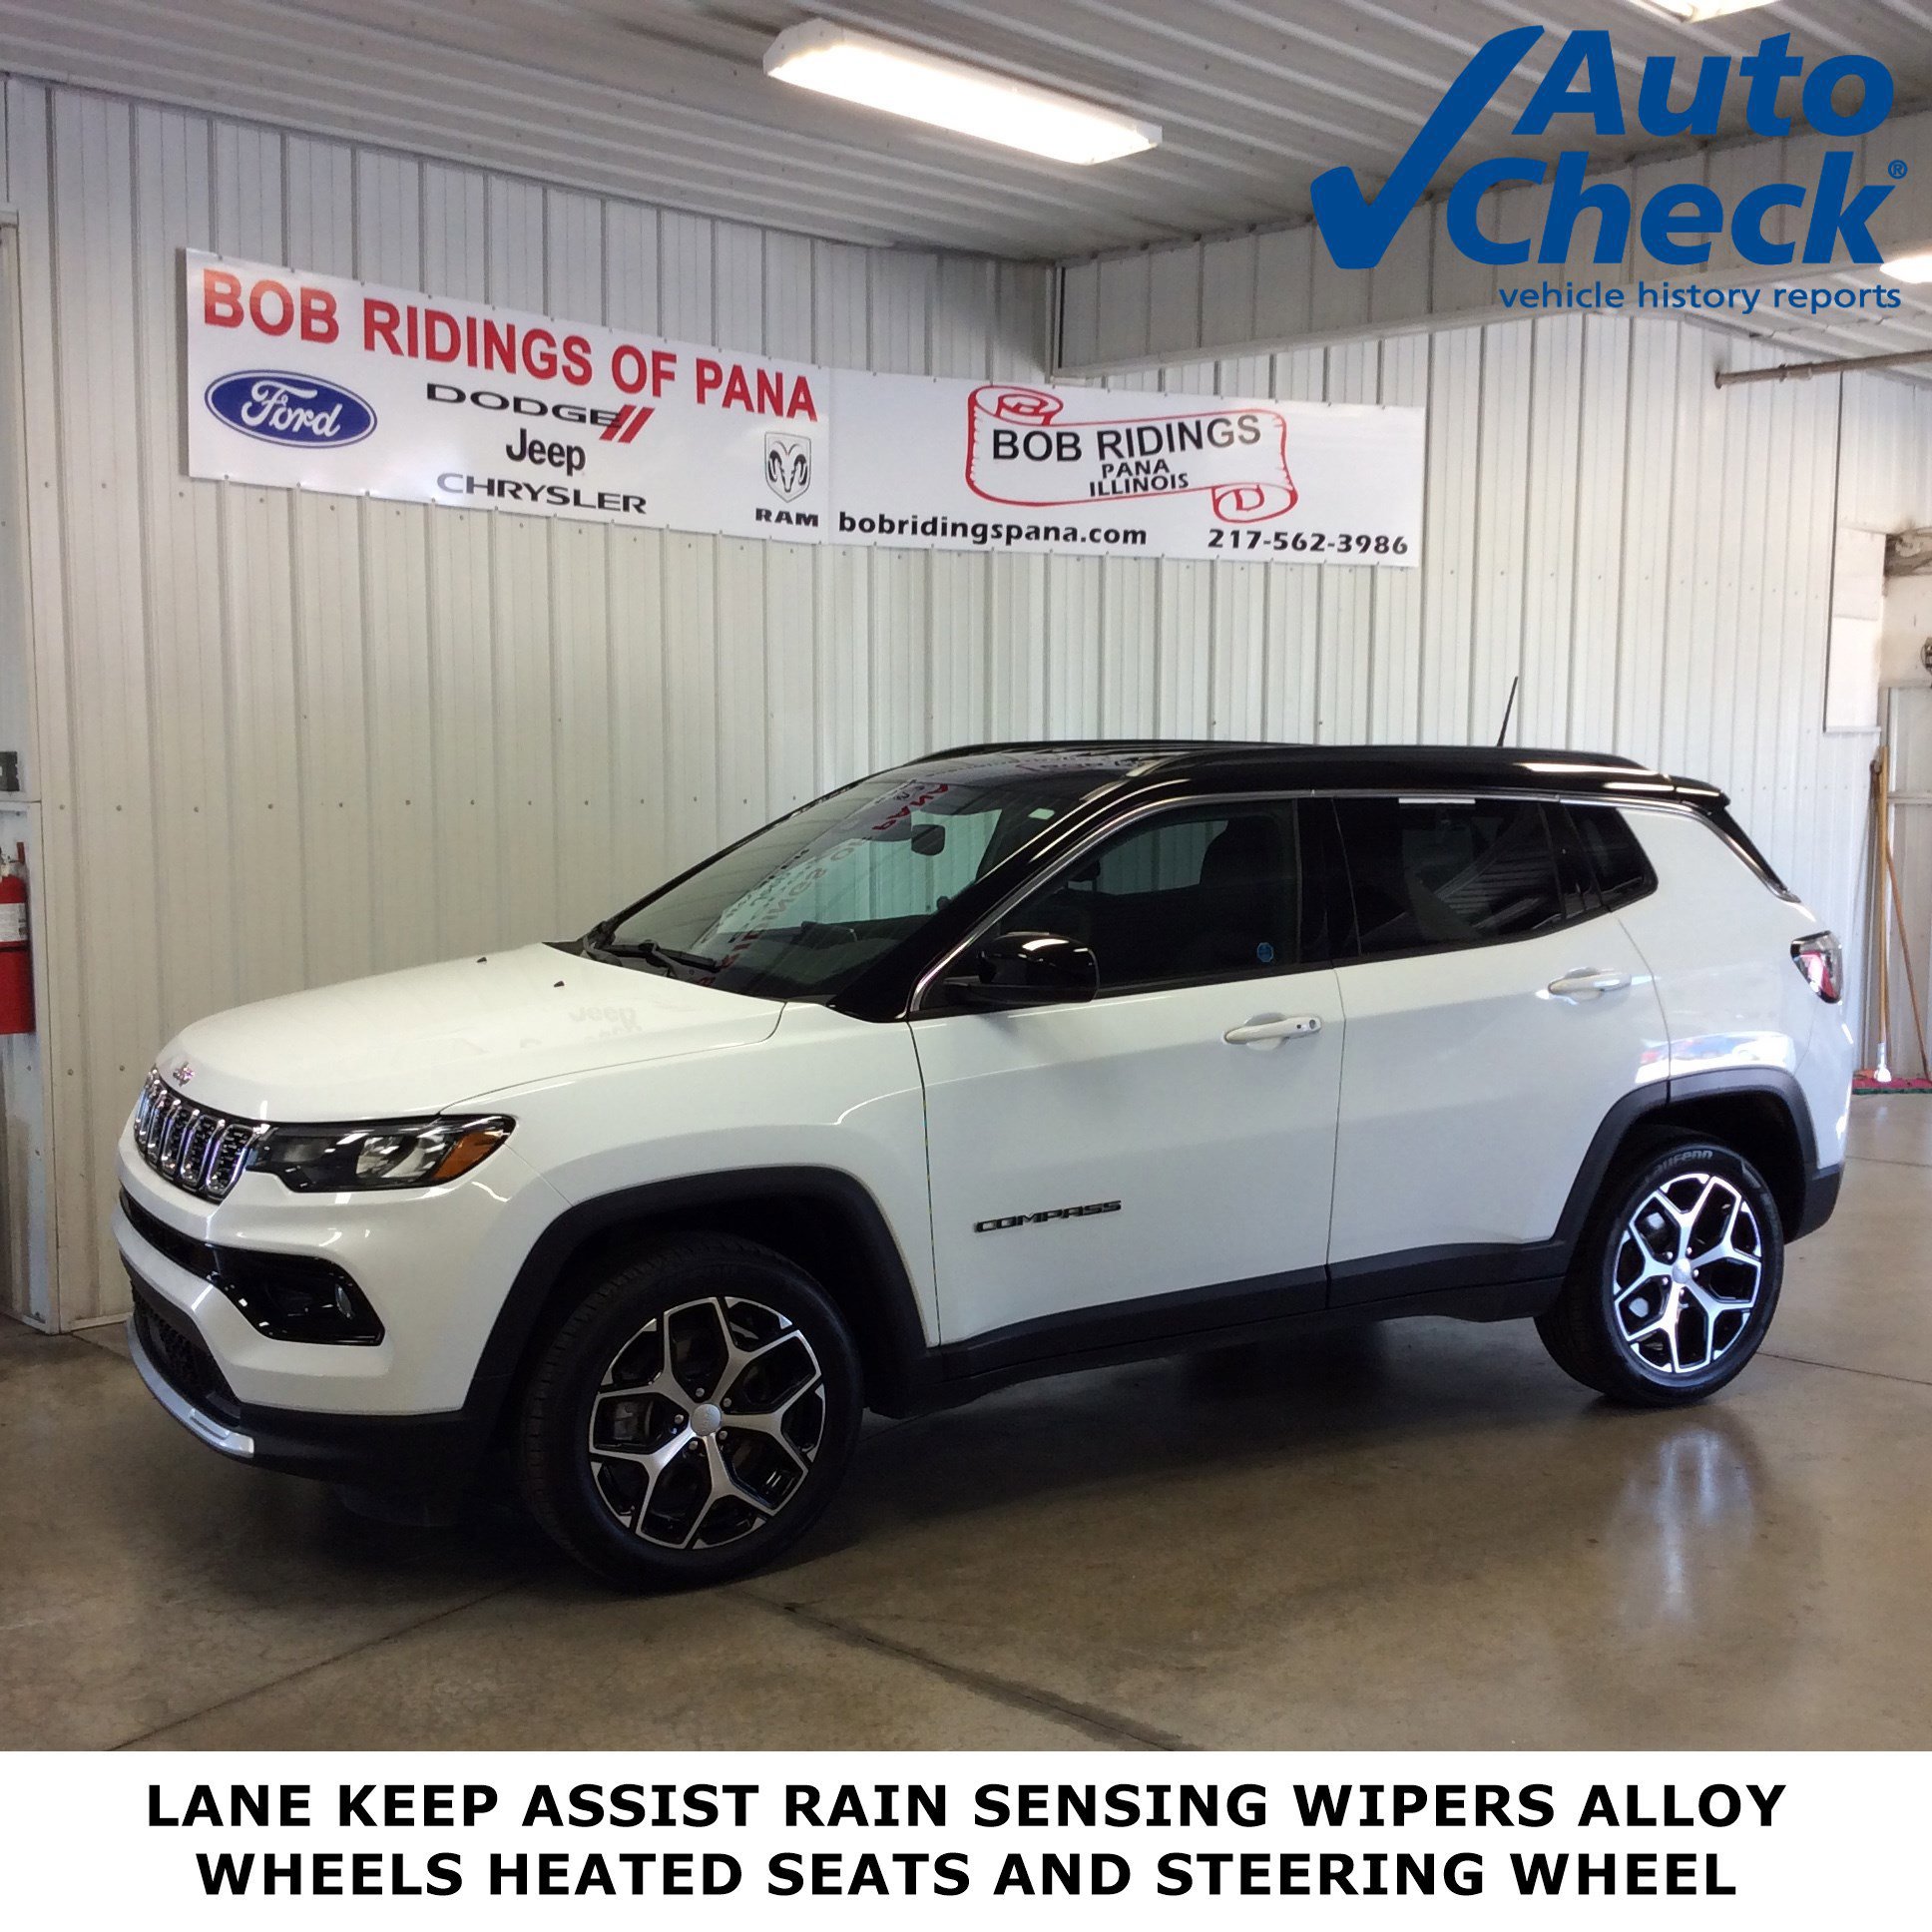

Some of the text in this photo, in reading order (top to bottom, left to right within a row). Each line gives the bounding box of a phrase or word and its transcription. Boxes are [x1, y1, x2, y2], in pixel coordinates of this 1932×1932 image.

[203, 269, 818, 422] BOB RIDINGS OF PANA
[241, 378, 342, 439] Ford
[427, 382, 624, 428] DODGE
[505, 427, 587, 477] Jeep
[992, 414, 1262, 462] BOB RIDINGS
[1088, 472, 1190, 498] ILLINOIS
[1100, 457, 1171, 479] PANA
[436, 472, 647, 514] CHRYSLER
[755, 508, 819, 528] RAM
[837, 511, 1148, 547] bobridingspana.com
[1208, 528, 1409, 557] 217-562-3986
[974, 1200, 1122, 1233] COMPASS
